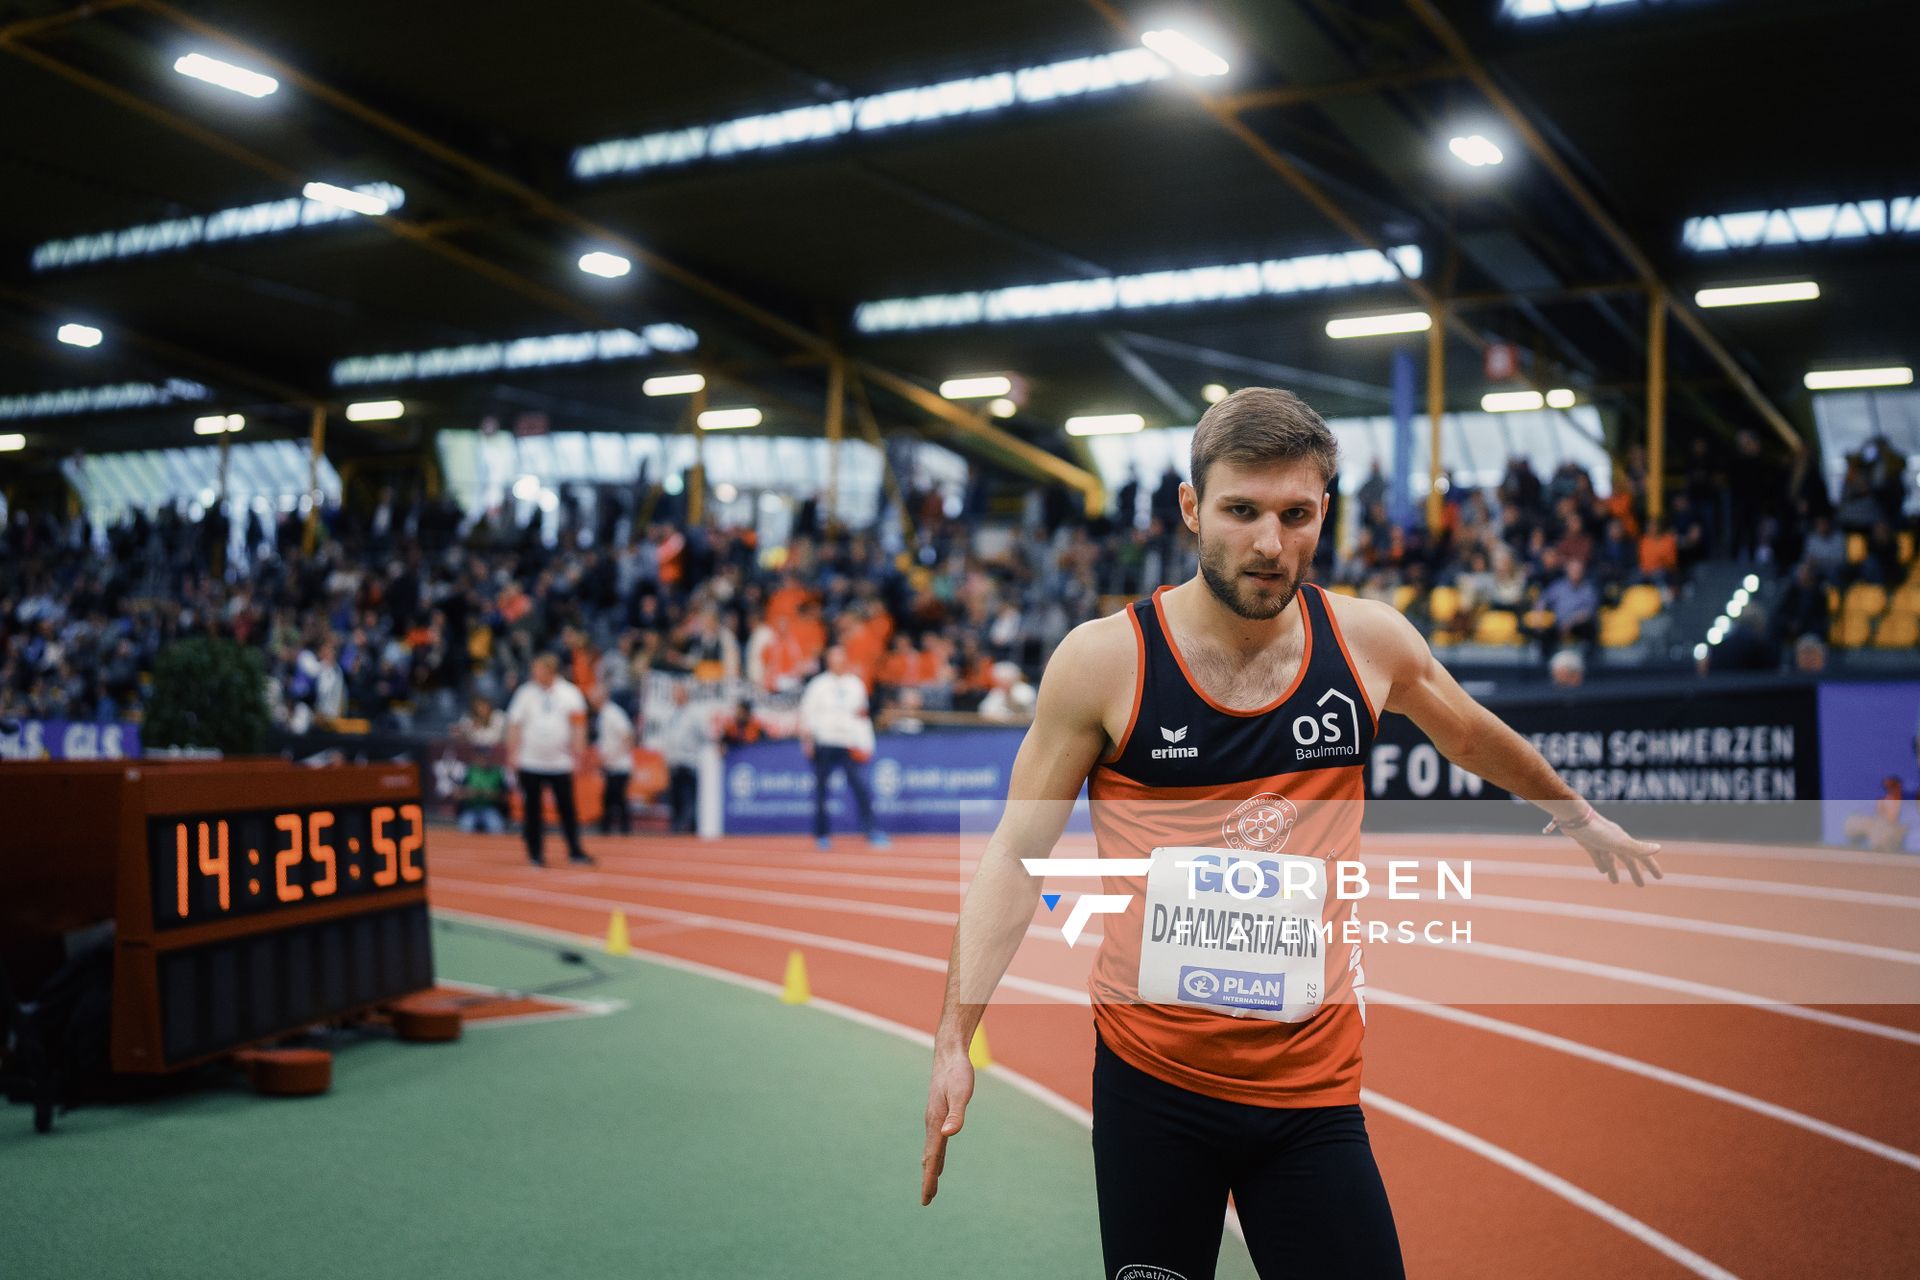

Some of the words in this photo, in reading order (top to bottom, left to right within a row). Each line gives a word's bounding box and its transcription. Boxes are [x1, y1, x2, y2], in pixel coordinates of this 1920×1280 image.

[1292, 712, 1341, 745] OS
[1526, 731, 1604, 766] EGEN
[1608, 726, 1795, 766] SCHMERZEN
[1152, 746, 1198, 759] erima
[1558, 767, 1796, 804] RSPANNUNGEN
[176, 803, 423, 919] 14:25:52
[1190, 854, 1280, 898] GLS
[1151, 903, 1318, 958] DAMMERMANN
[1223, 976, 1281, 997] PLAN
[1223, 995, 1279, 1006] INTERNATIONAL
[1307, 982, 1317, 1006] 221
